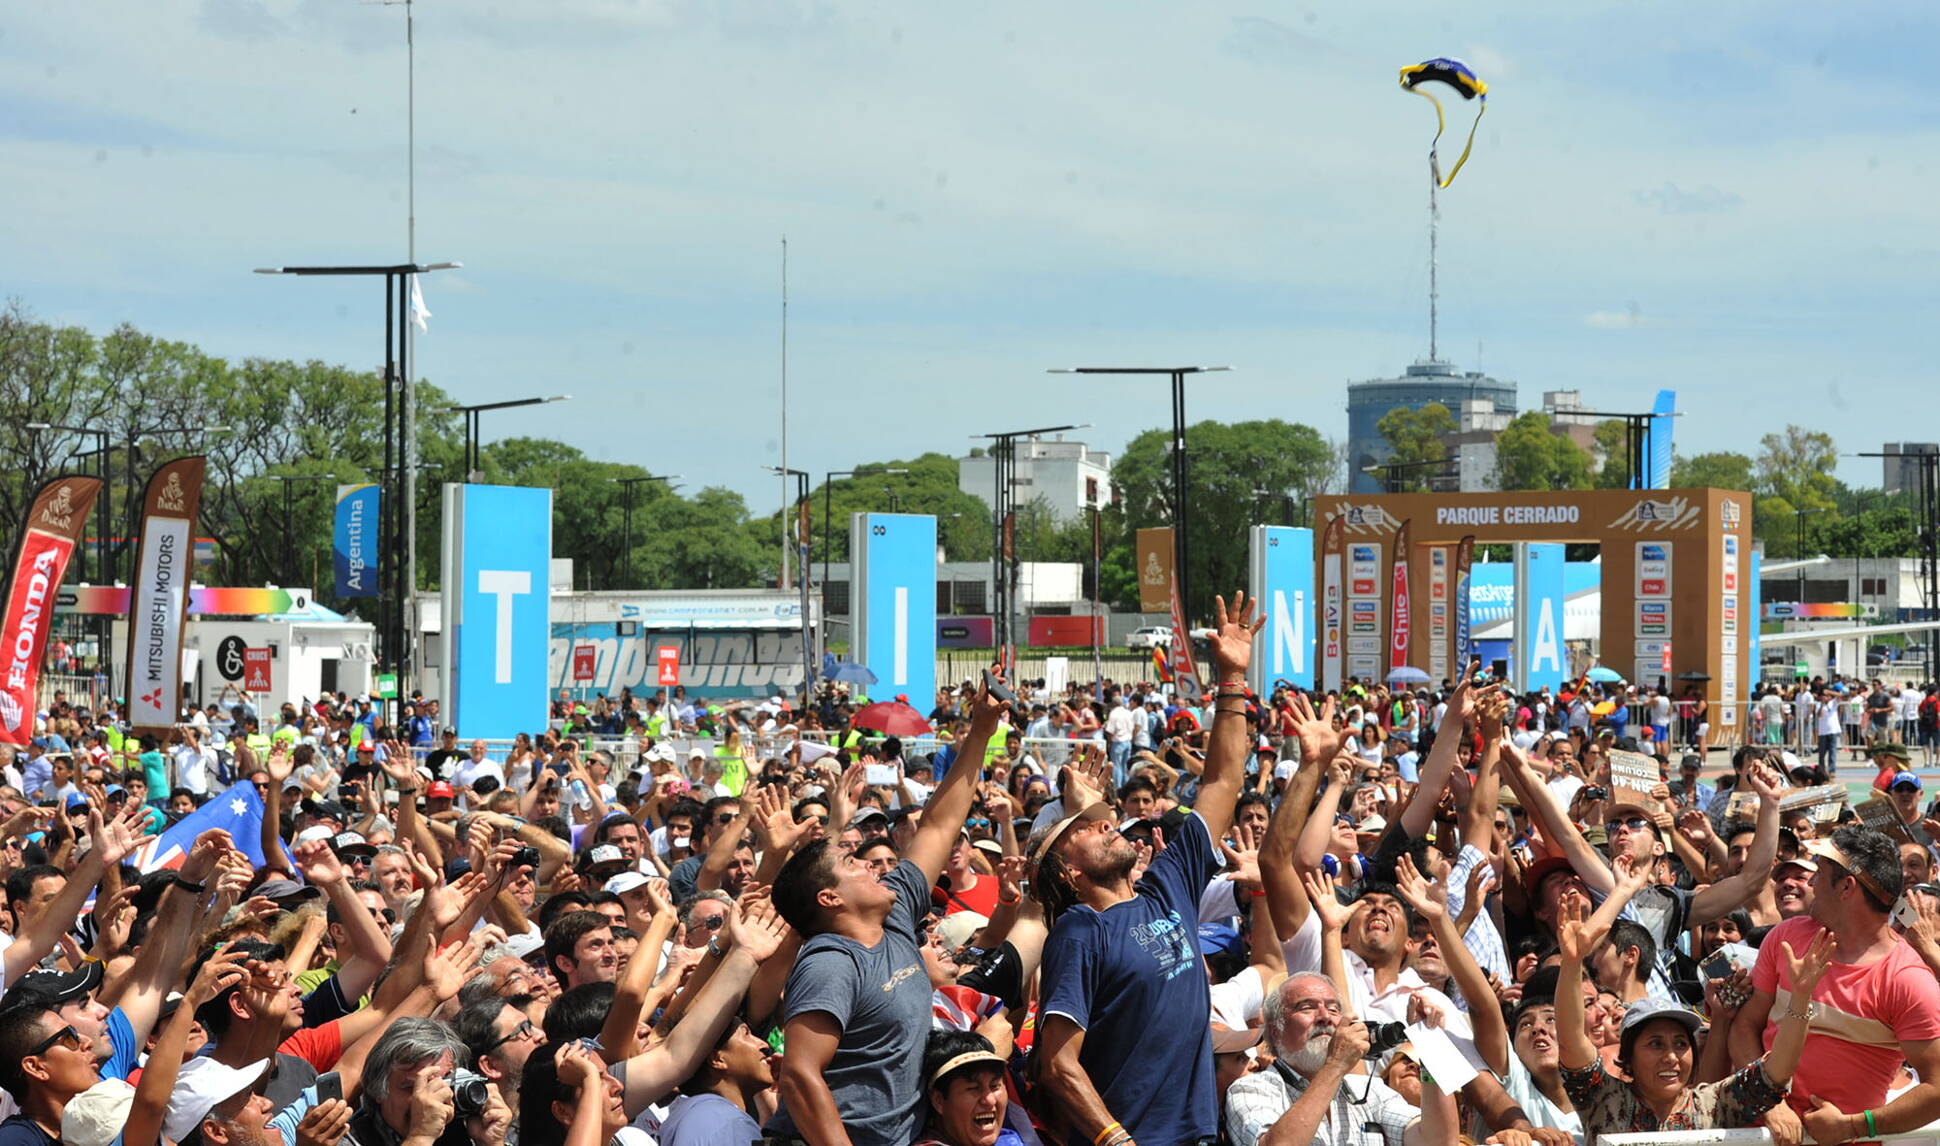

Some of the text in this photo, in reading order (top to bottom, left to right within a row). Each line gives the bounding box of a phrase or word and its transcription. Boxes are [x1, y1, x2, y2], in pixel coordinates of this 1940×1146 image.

[347, 499, 364, 590] Argentina
[1437, 506, 1579, 526] PARQUE CERRADO
[7, 547, 59, 690] HONDA
[148, 534, 175, 682] MITSUBISHI MOTORS
[478, 570, 532, 684] T
[1273, 590, 1304, 674] N
[1327, 585, 1338, 658] Bolivia
[1394, 594, 1408, 651] Chile
[1531, 598, 1560, 673] A
